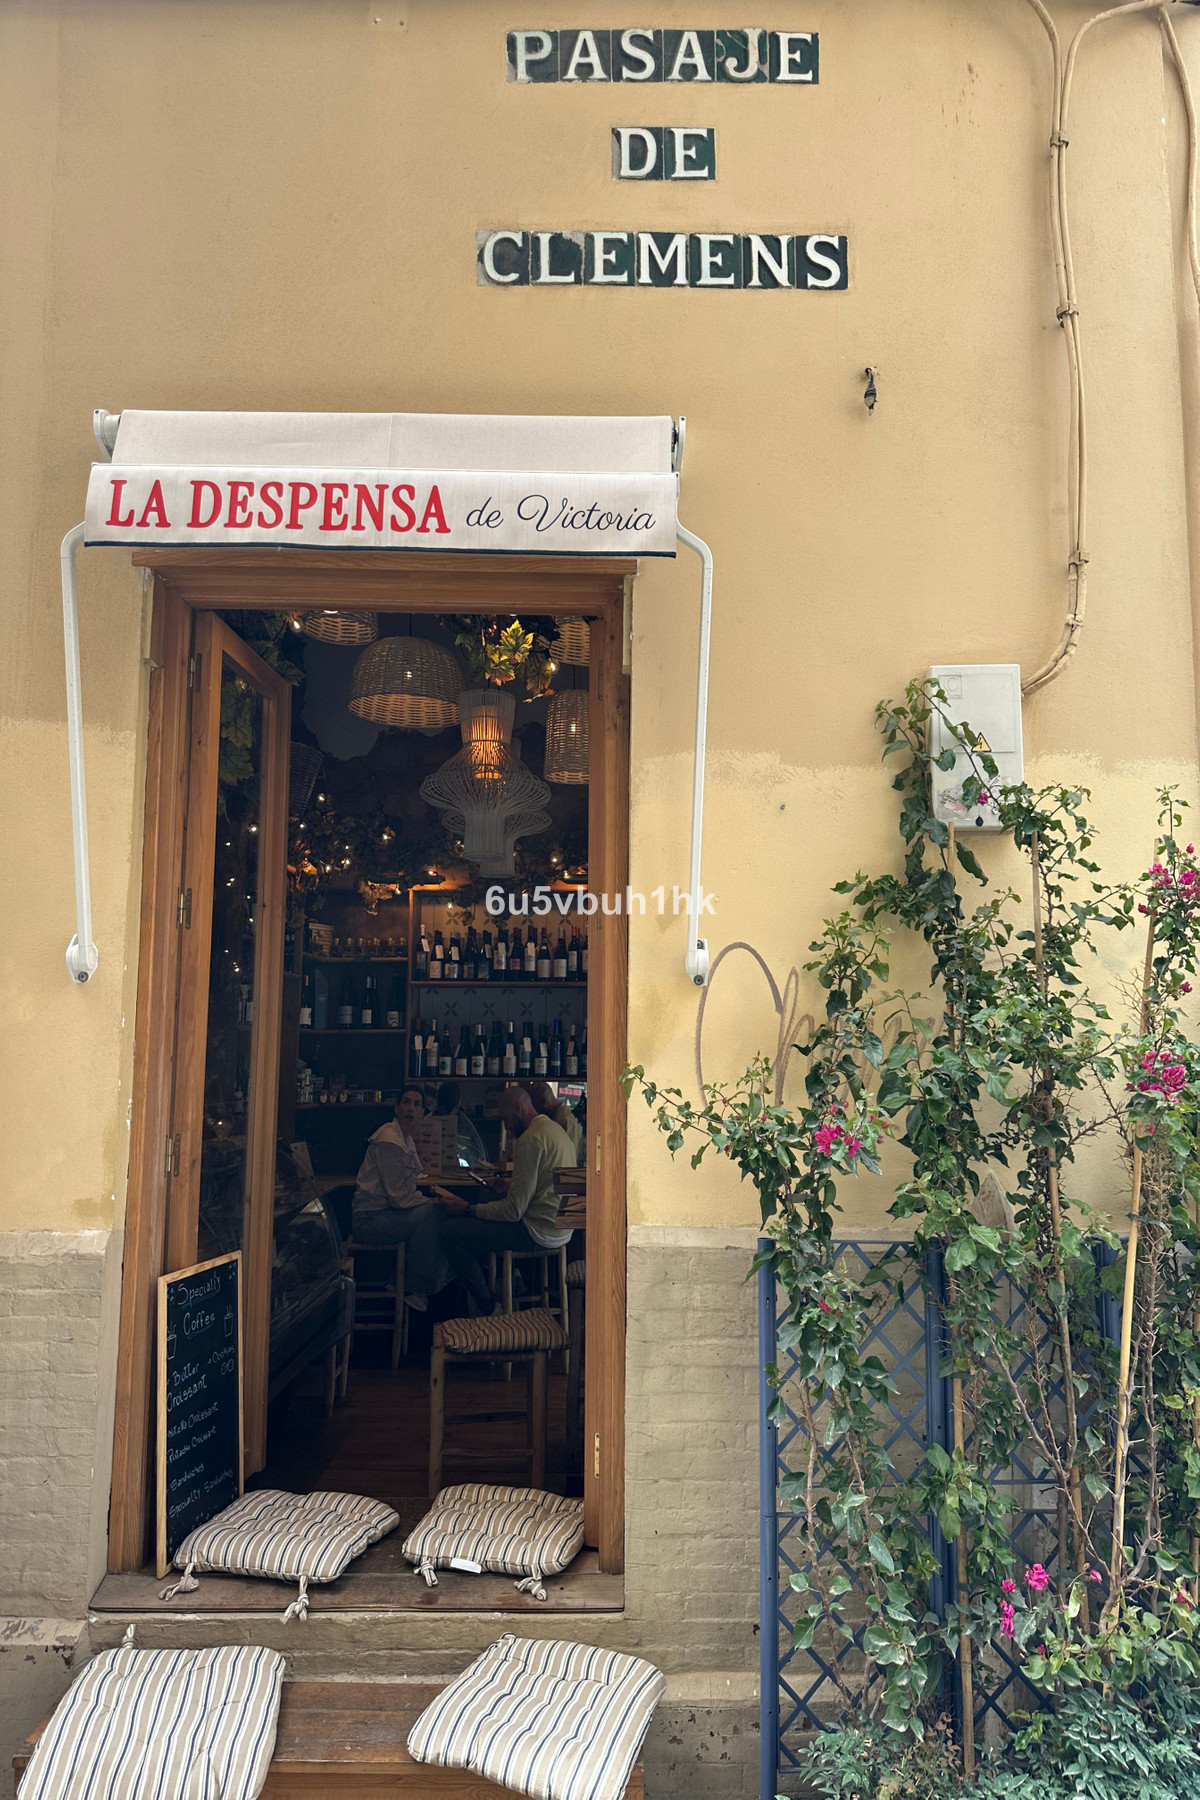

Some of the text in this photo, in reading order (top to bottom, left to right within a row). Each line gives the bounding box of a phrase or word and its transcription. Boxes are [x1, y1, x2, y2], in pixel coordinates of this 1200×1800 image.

[511, 28, 813, 83] PASAJE
[616, 127, 709, 179] DE
[483, 230, 842, 288] CLEMENS
[105, 479, 657, 534] LA DESPENSA de Victoria
[177, 1270, 221, 1308] Specialty
[183, 1310, 216, 1336] Coffee
[166, 1374, 208, 1412] Croissant
[172, 1362, 200, 1386] Butter
